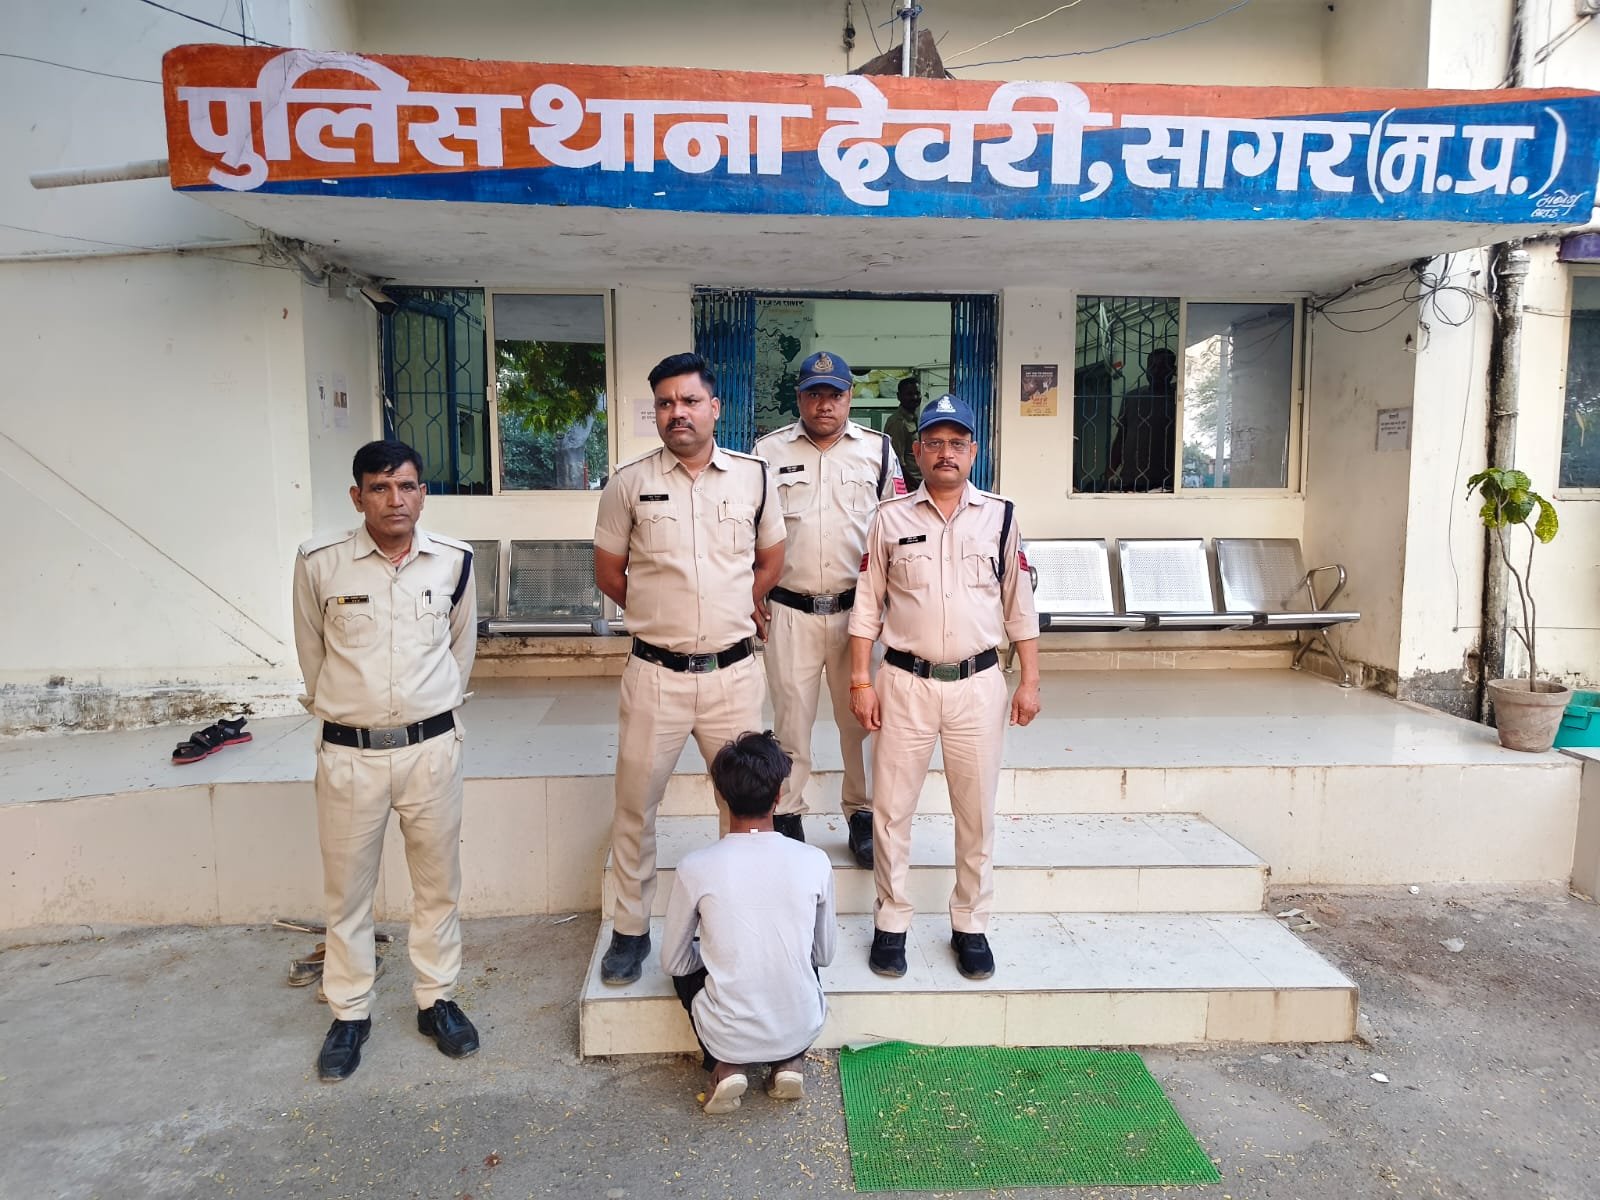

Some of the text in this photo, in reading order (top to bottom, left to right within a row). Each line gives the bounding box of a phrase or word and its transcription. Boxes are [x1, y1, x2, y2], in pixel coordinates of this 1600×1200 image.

[177, 50, 524, 191] पुलिस
[528, 83, 813, 175] थाना
[817, 74, 1113, 206] देवरी,
[1120, 114, 1371, 193] सागर
